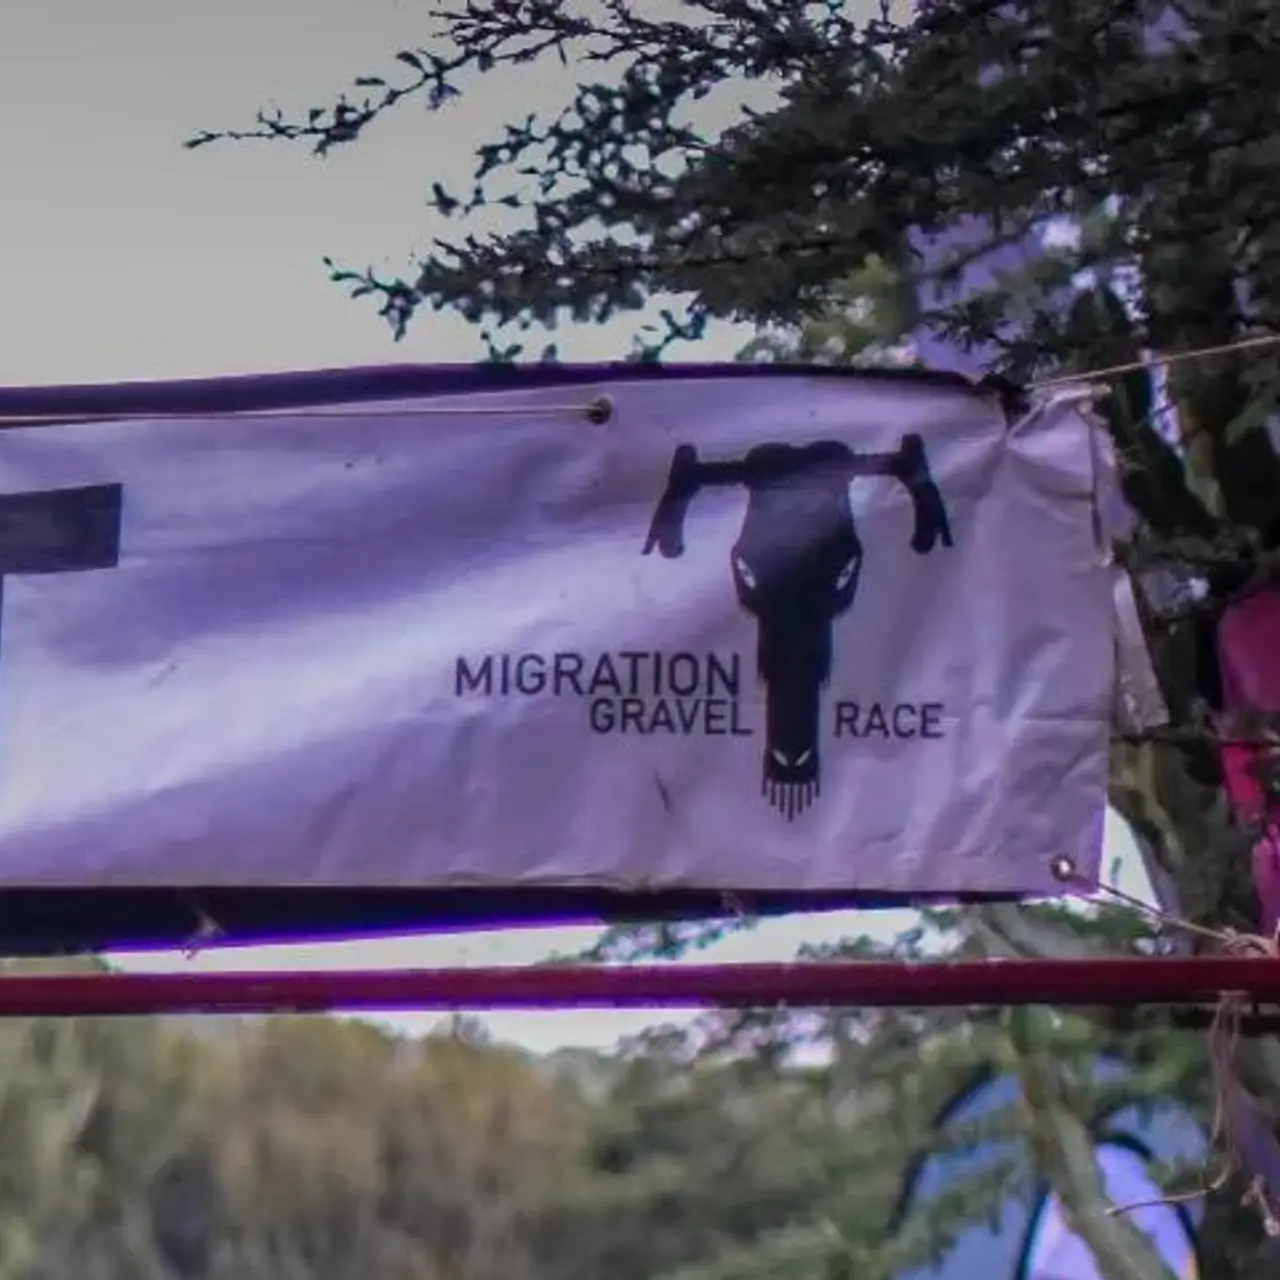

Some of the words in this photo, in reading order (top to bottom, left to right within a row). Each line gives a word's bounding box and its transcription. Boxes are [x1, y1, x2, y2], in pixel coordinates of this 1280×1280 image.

[454, 651, 740, 698] MIGRATION
[589, 698, 753, 738] GRAVEL
[833, 701, 945, 740] RACE
